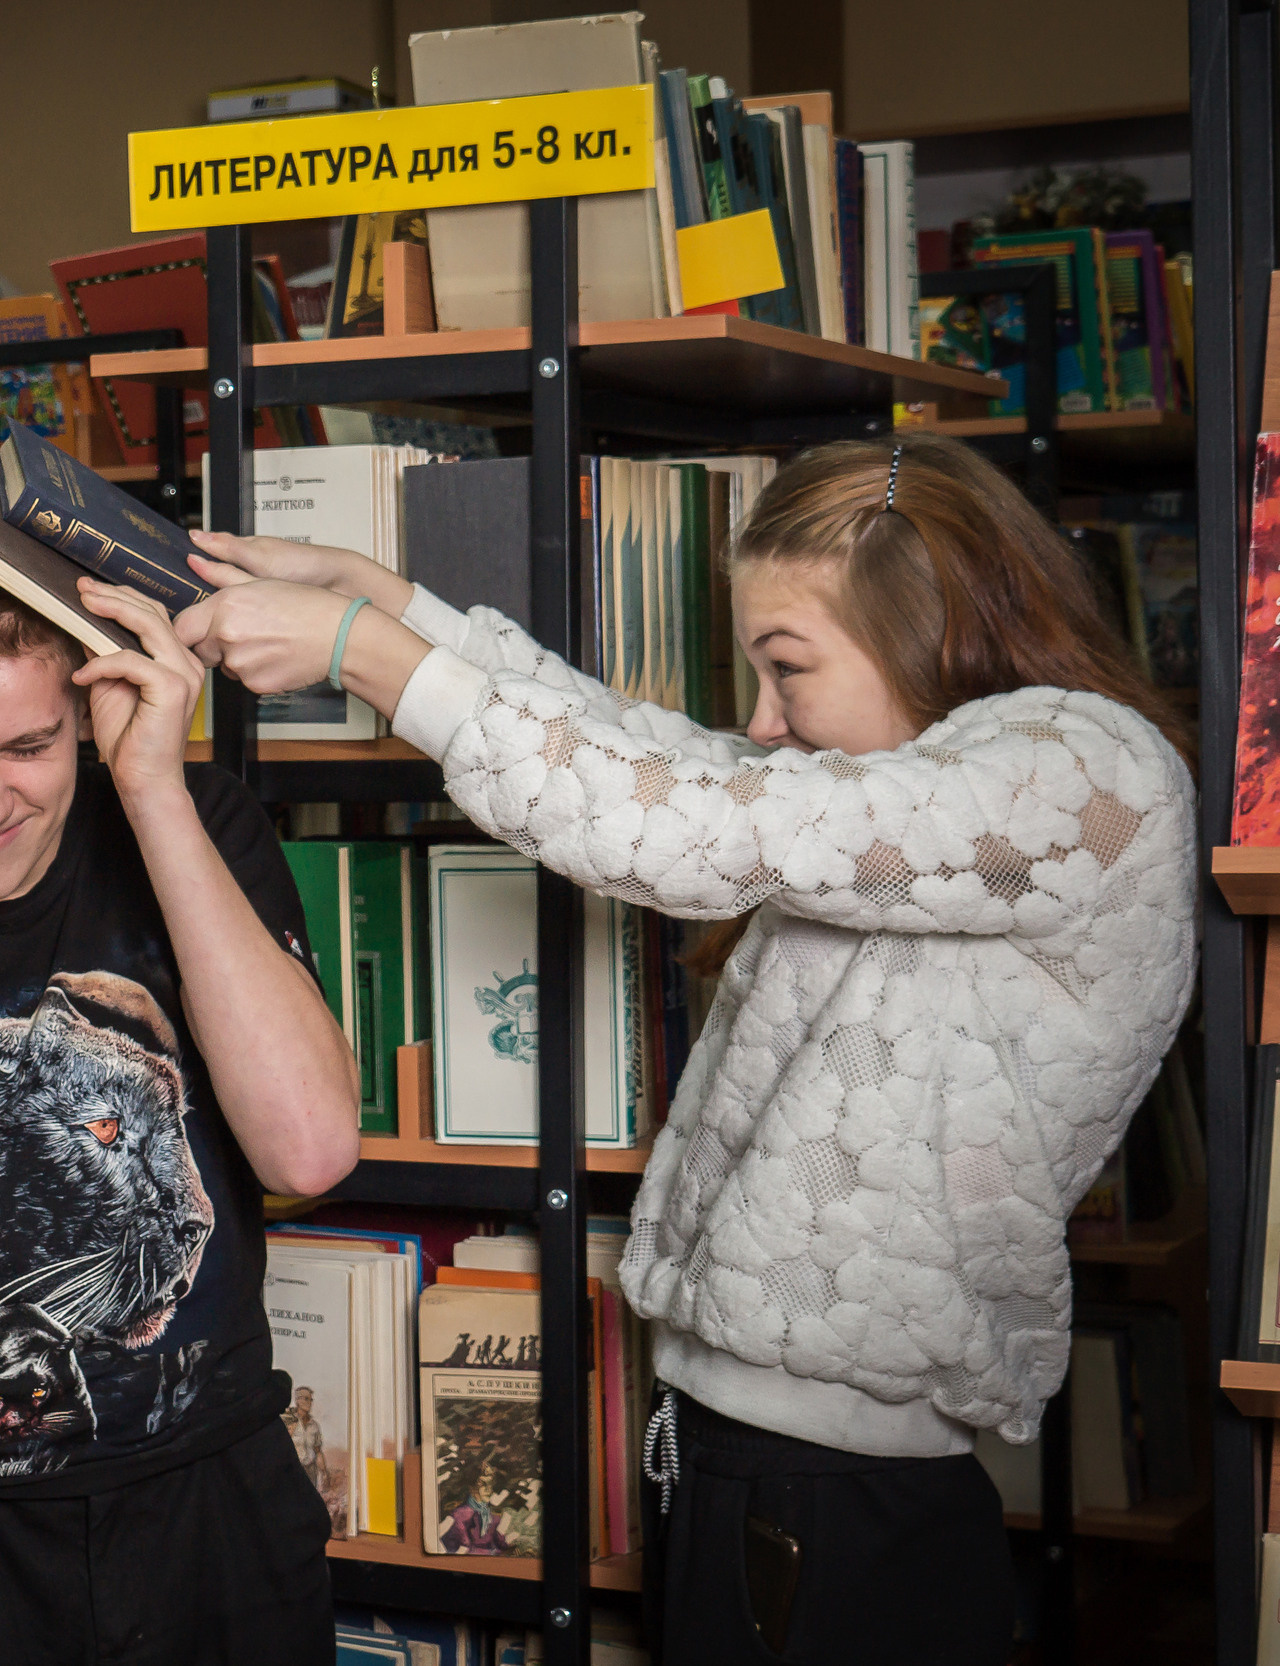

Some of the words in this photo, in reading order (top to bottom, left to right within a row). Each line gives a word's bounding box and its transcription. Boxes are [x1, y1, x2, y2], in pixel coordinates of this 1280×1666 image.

[149, 143, 398, 200] ЛИТЕРАТУРА
[408, 144, 480, 183] для
[492, 125, 560, 169] 5-8
[573, 128, 632, 161] кл.
[261, 499, 316, 512] ЖИТКОВ
